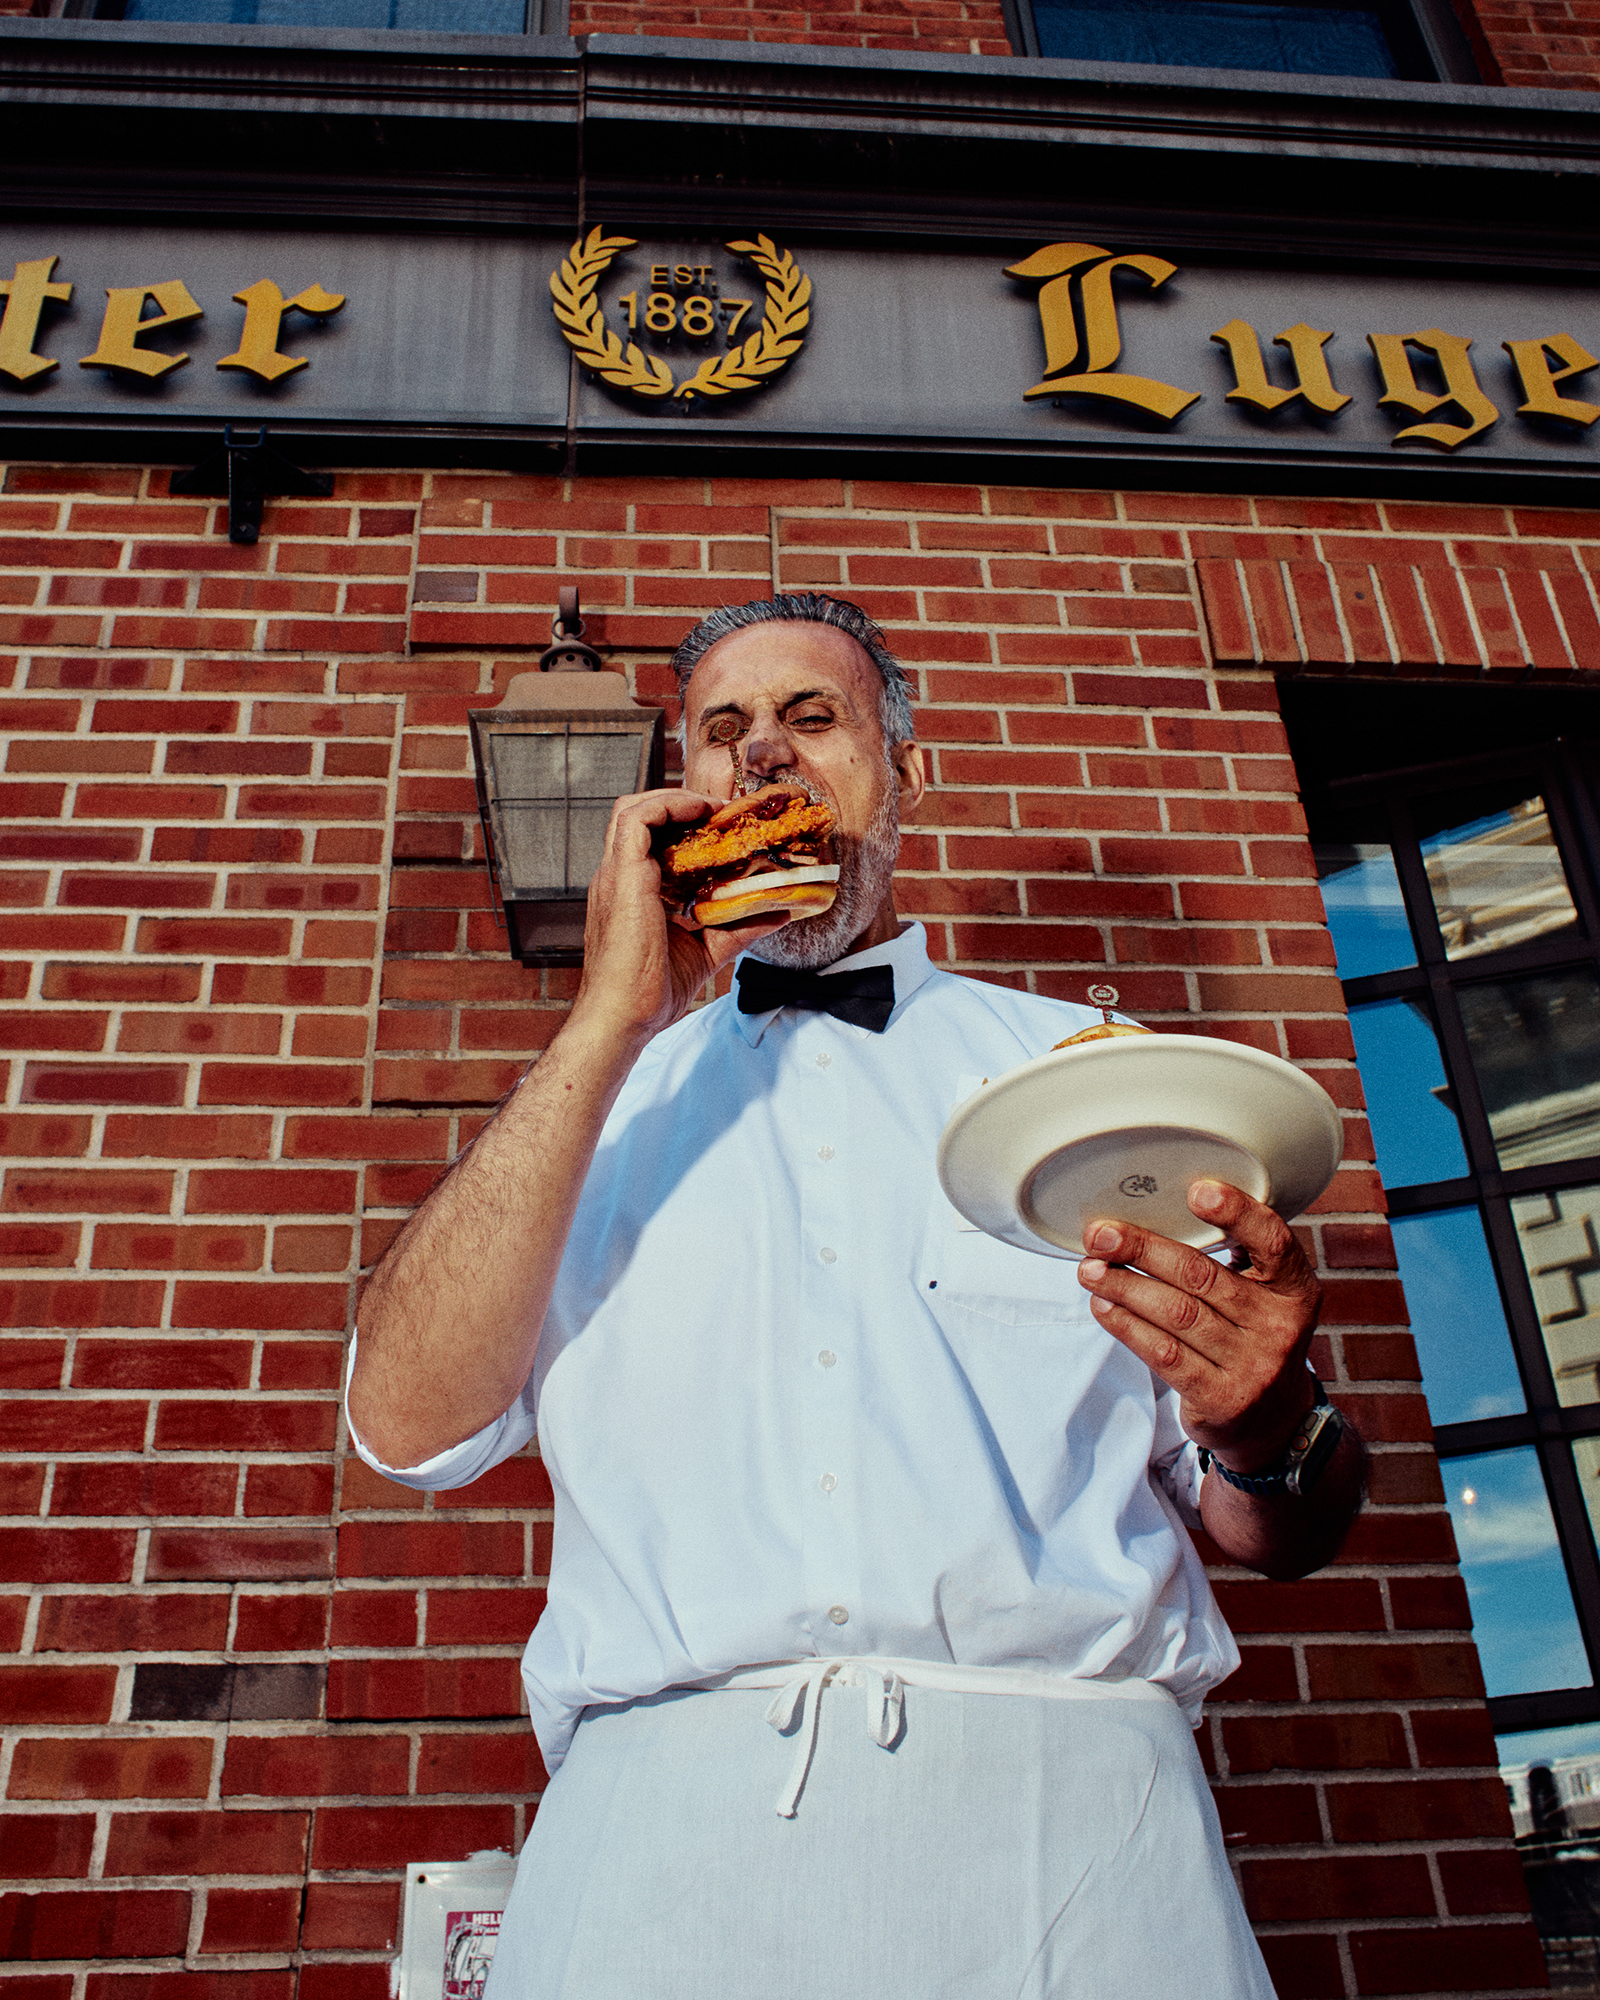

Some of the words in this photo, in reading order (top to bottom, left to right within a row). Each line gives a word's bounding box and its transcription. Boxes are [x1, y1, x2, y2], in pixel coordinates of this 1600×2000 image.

[650, 264, 718, 289] EST.
[619, 290, 753, 338] 1887
[0, 256, 346, 384] ter
[1002, 242, 1600, 453] Luge
